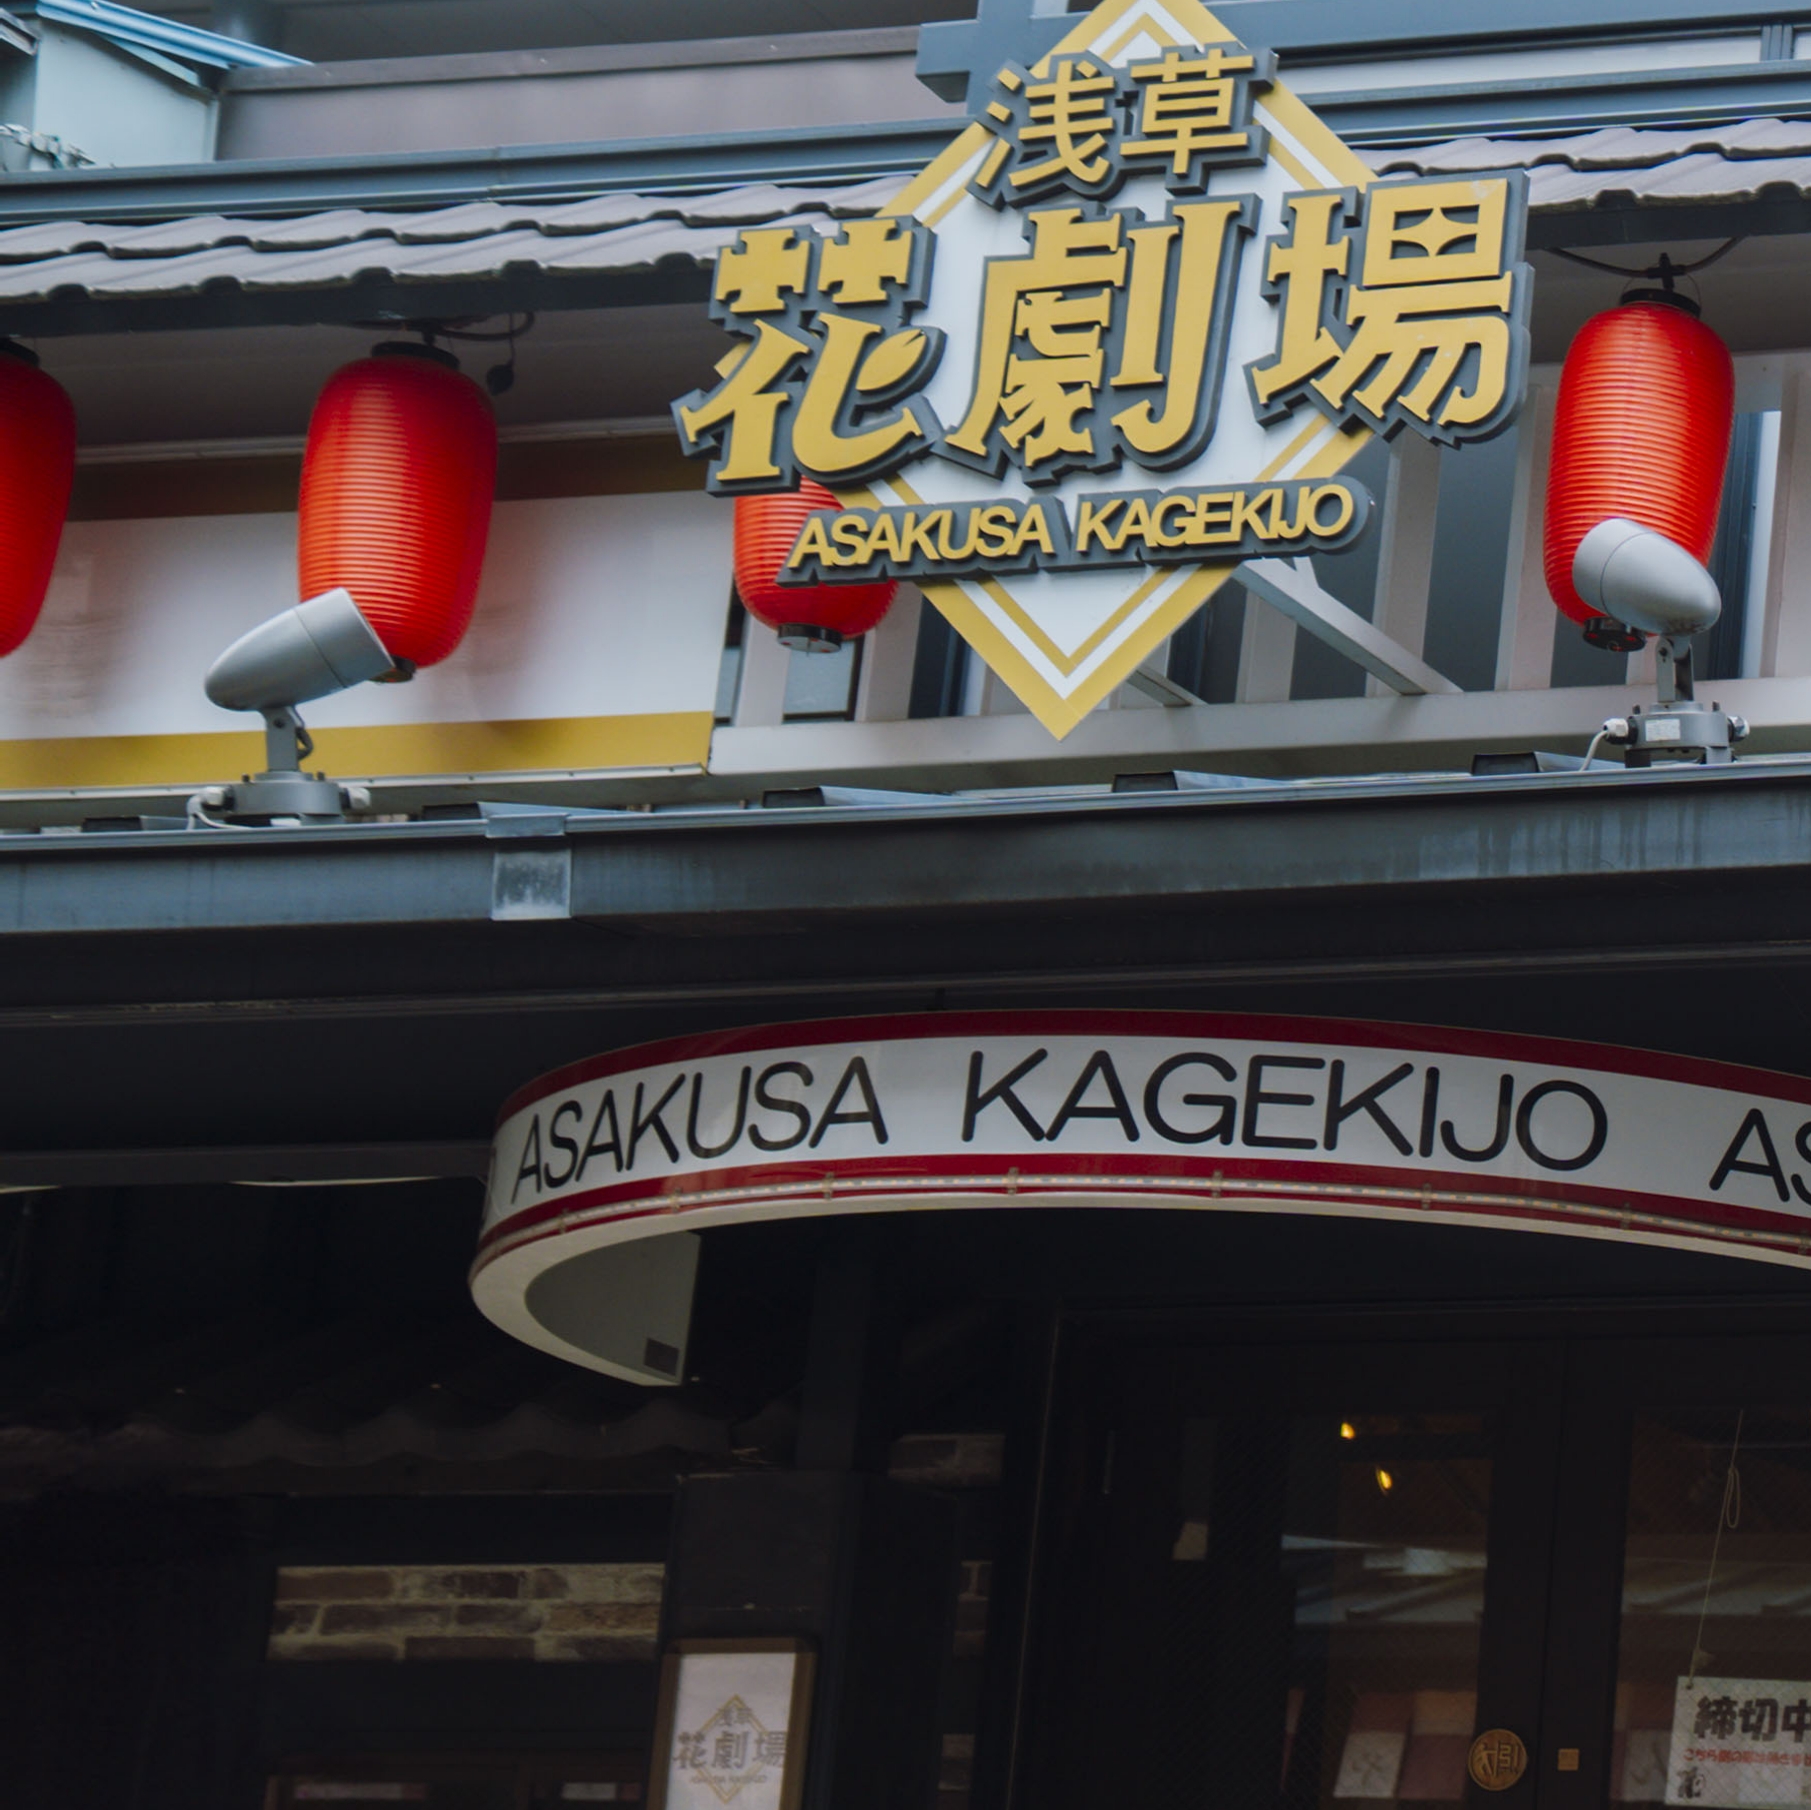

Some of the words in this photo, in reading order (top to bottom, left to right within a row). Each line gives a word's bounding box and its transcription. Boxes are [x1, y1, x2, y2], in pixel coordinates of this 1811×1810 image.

[975, 46, 1257, 190] 浅草
[680, 174, 1514, 484] 花劇場
[786, 499, 1055, 569] ASAKUSA
[1074, 482, 1355, 553] KAGEKIJO
[511, 1056, 888, 1205] ASAKUSA
[962, 1048, 1608, 1171] KAGEKIJO
[673, 1731, 787, 1769] 花劇場
